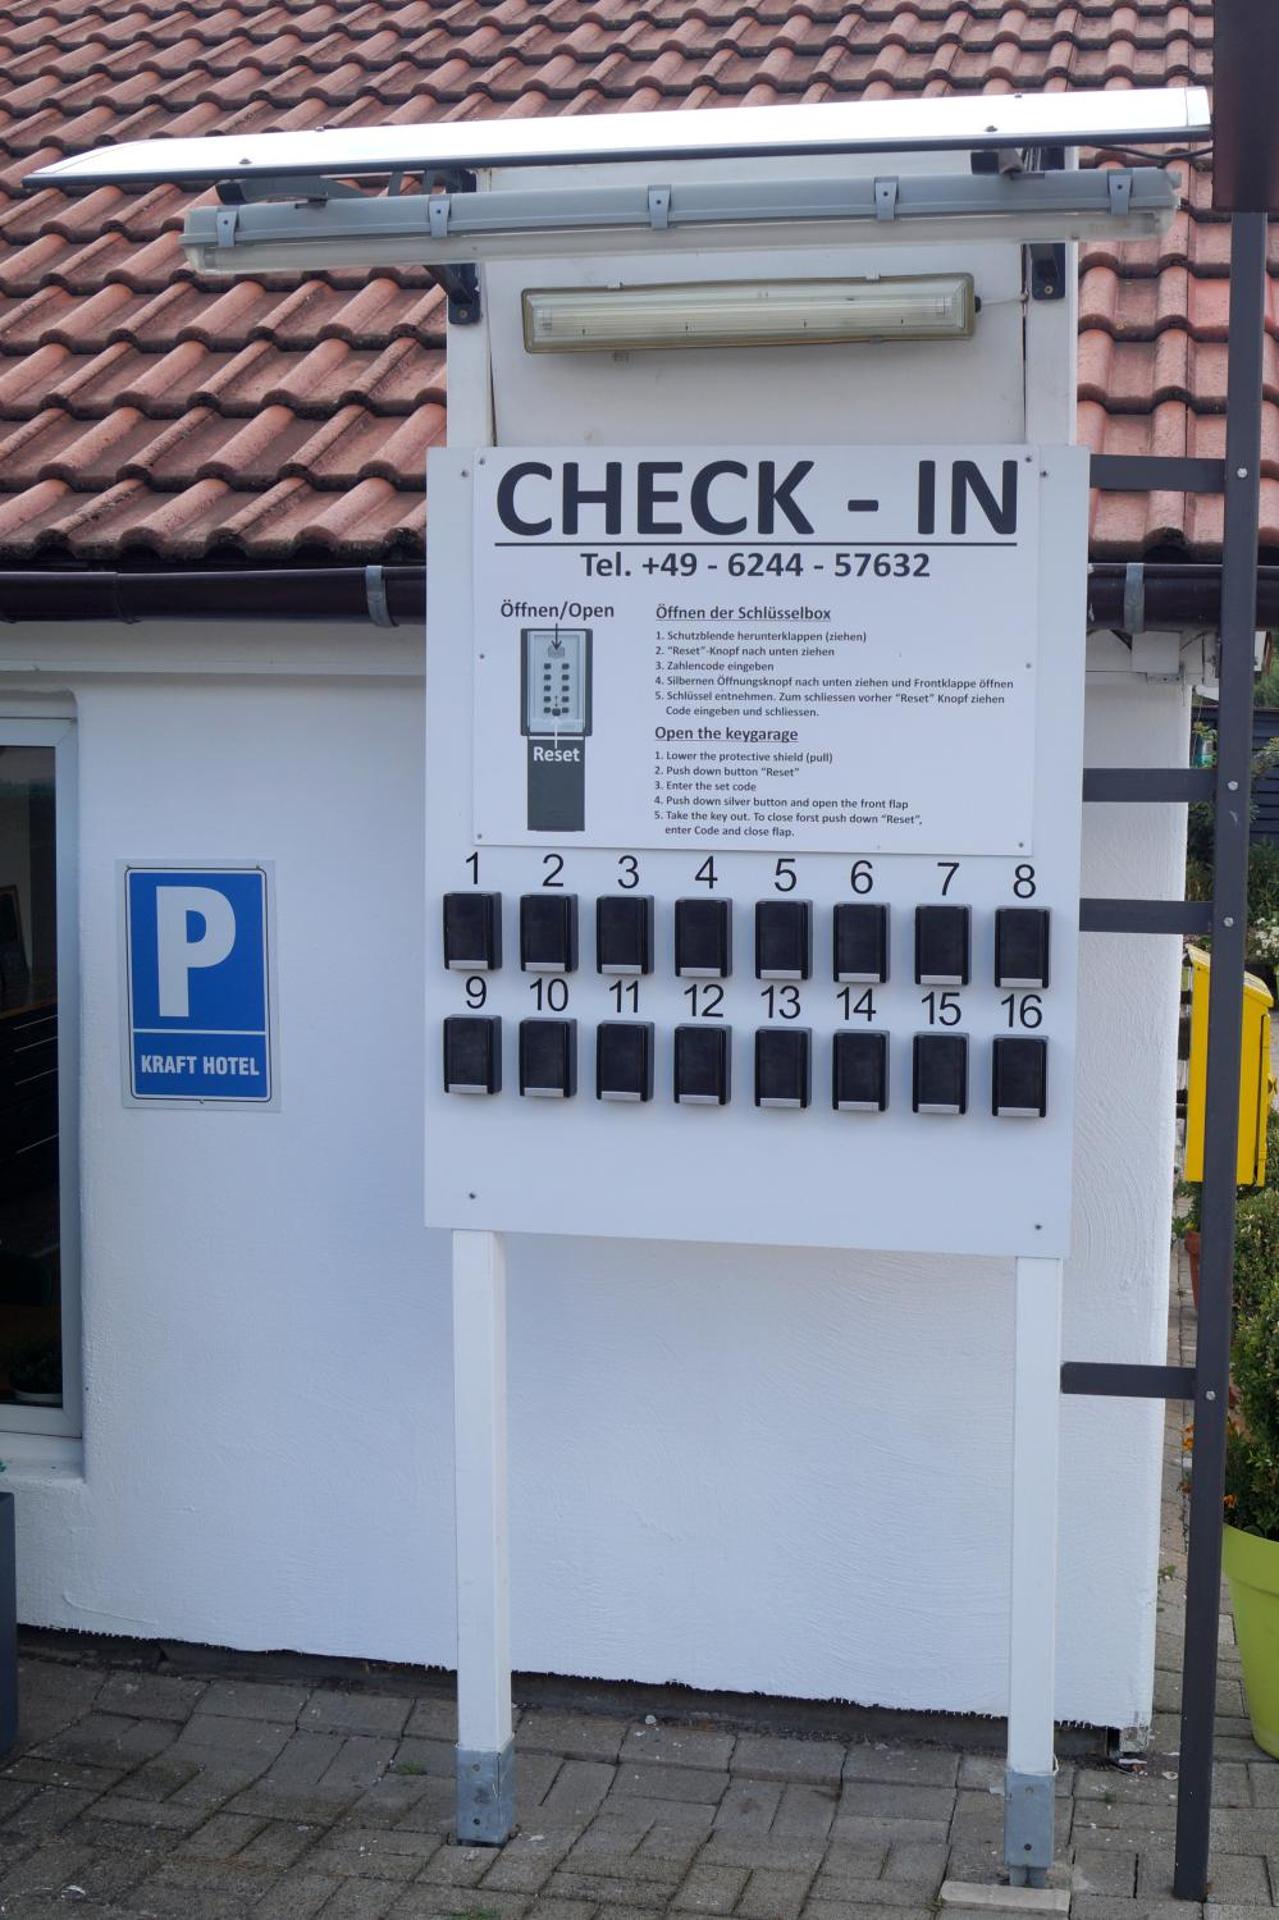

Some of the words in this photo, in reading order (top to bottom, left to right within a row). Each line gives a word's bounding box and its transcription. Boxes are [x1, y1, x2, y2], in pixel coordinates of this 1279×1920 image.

[496, 460, 815, 536] CHECK
[848, 499, 879, 512] -
[918, 460, 1018, 535] IN
[581, 552, 630, 578] Tel.
[642, 552, 698, 577] +49
[728, 552, 804, 577] 6244
[834, 552, 930, 578] 57632
[500, 599, 614, 620] Öffnen/Open
[656, 603, 705, 619] Öffnen
[710, 606, 734, 619] der
[738, 607, 831, 620] Schlüsselbox
[656, 632, 664, 640] 1.
[668, 631, 734, 641] Schutzblende
[738, 632, 822, 642] herunterklappen
[825, 632, 866, 643] (ziehen)
[656, 647, 664, 655] 2.
[742, 647, 766, 656] nach
[769, 648, 798, 656] unten
[801, 647, 834, 656] ziehen
[668, 661, 724, 670] Zahlencode
[728, 662, 774, 672] eingeben
[667, 676, 714, 685] Silbernen
[717, 674, 792, 687] Öffnungsknopf
[795, 678, 819, 686] nach
[822, 678, 852, 686] unten
[855, 678, 888, 687] ziehen
[892, 678, 911, 687] und
[914, 679, 976, 689] Frontklappe
[979, 679, 1013, 688] öffnen
[655, 692, 664, 700] 5.
[667, 691, 712, 700] Schlüssel
[715, 692, 775, 701] entnehmen.
[779, 693, 801, 701] Zum
[804, 692, 856, 702] schliessen
[858, 693, 892, 702] vorher
[938, 694, 968, 704] Knopf
[971, 695, 1004, 703] ziehen
[666, 706, 691, 715] Code
[694, 706, 740, 717] eingeben
[743, 707, 762, 716] und
[765, 707, 819, 716] schliessen.
[655, 727, 693, 741] Open
[698, 727, 722, 739] the
[726, 727, 798, 743] keygarage
[533, 746, 580, 762] Reset
[655, 752, 663, 760] 1.
[667, 752, 697, 761] Lower
[700, 752, 717, 761] the
[719, 752, 770, 762] protective
[773, 752, 803, 762] shield
[806, 752, 832, 763] (pull)
[667, 767, 690, 775] Push
[693, 767, 721, 776] down
[724, 767, 758, 776] button
[667, 782, 692, 790] Enter
[696, 782, 712, 790] the
[733, 782, 757, 791] code
[654, 796, 663, 804] 4.
[666, 796, 690, 805] Push
[693, 797, 721, 806] down
[724, 797, 751, 806] silver
[754, 798, 787, 807] button
[790, 798, 810, 807] and
[812, 800, 838, 809] open
[841, 799, 858, 808] the
[861, 799, 886, 808] front
[889, 799, 908, 810] flap
[654, 811, 663, 819] 5.
[666, 811, 688, 820] Take
[691, 812, 708, 820] the
[710, 812, 727, 823] key
[754, 813, 765, 821] To
[768, 813, 793, 822] close
[796, 813, 819, 822] forst
[822, 814, 847, 824] push
[850, 814, 878, 823] down
[694, 826, 719, 835] Code
[722, 826, 741, 835] and
[744, 827, 769, 836] close
[772, 827, 794, 838] flap.
[466, 852, 479, 885] 1
[542, 854, 564, 887] 2
[618, 855, 639, 889] 3
[694, 856, 718, 889] 4
[774, 859, 797, 892] 5
[850, 860, 873, 894] 6
[937, 862, 960, 896] 7
[1013, 864, 1036, 898] 8
[156, 886, 236, 1017] P
[466, 976, 486, 1009] 9
[530, 978, 568, 1011] 10
[609, 980, 639, 1013] 11
[684, 984, 724, 1017] 12
[761, 985, 801, 1019] 13
[836, 988, 876, 1022] 14
[921, 992, 961, 1025] 15
[1001, 995, 1042, 1028] 16
[141, 1055, 197, 1074] KRAFT
[203, 1056, 259, 1076] HOTEL
